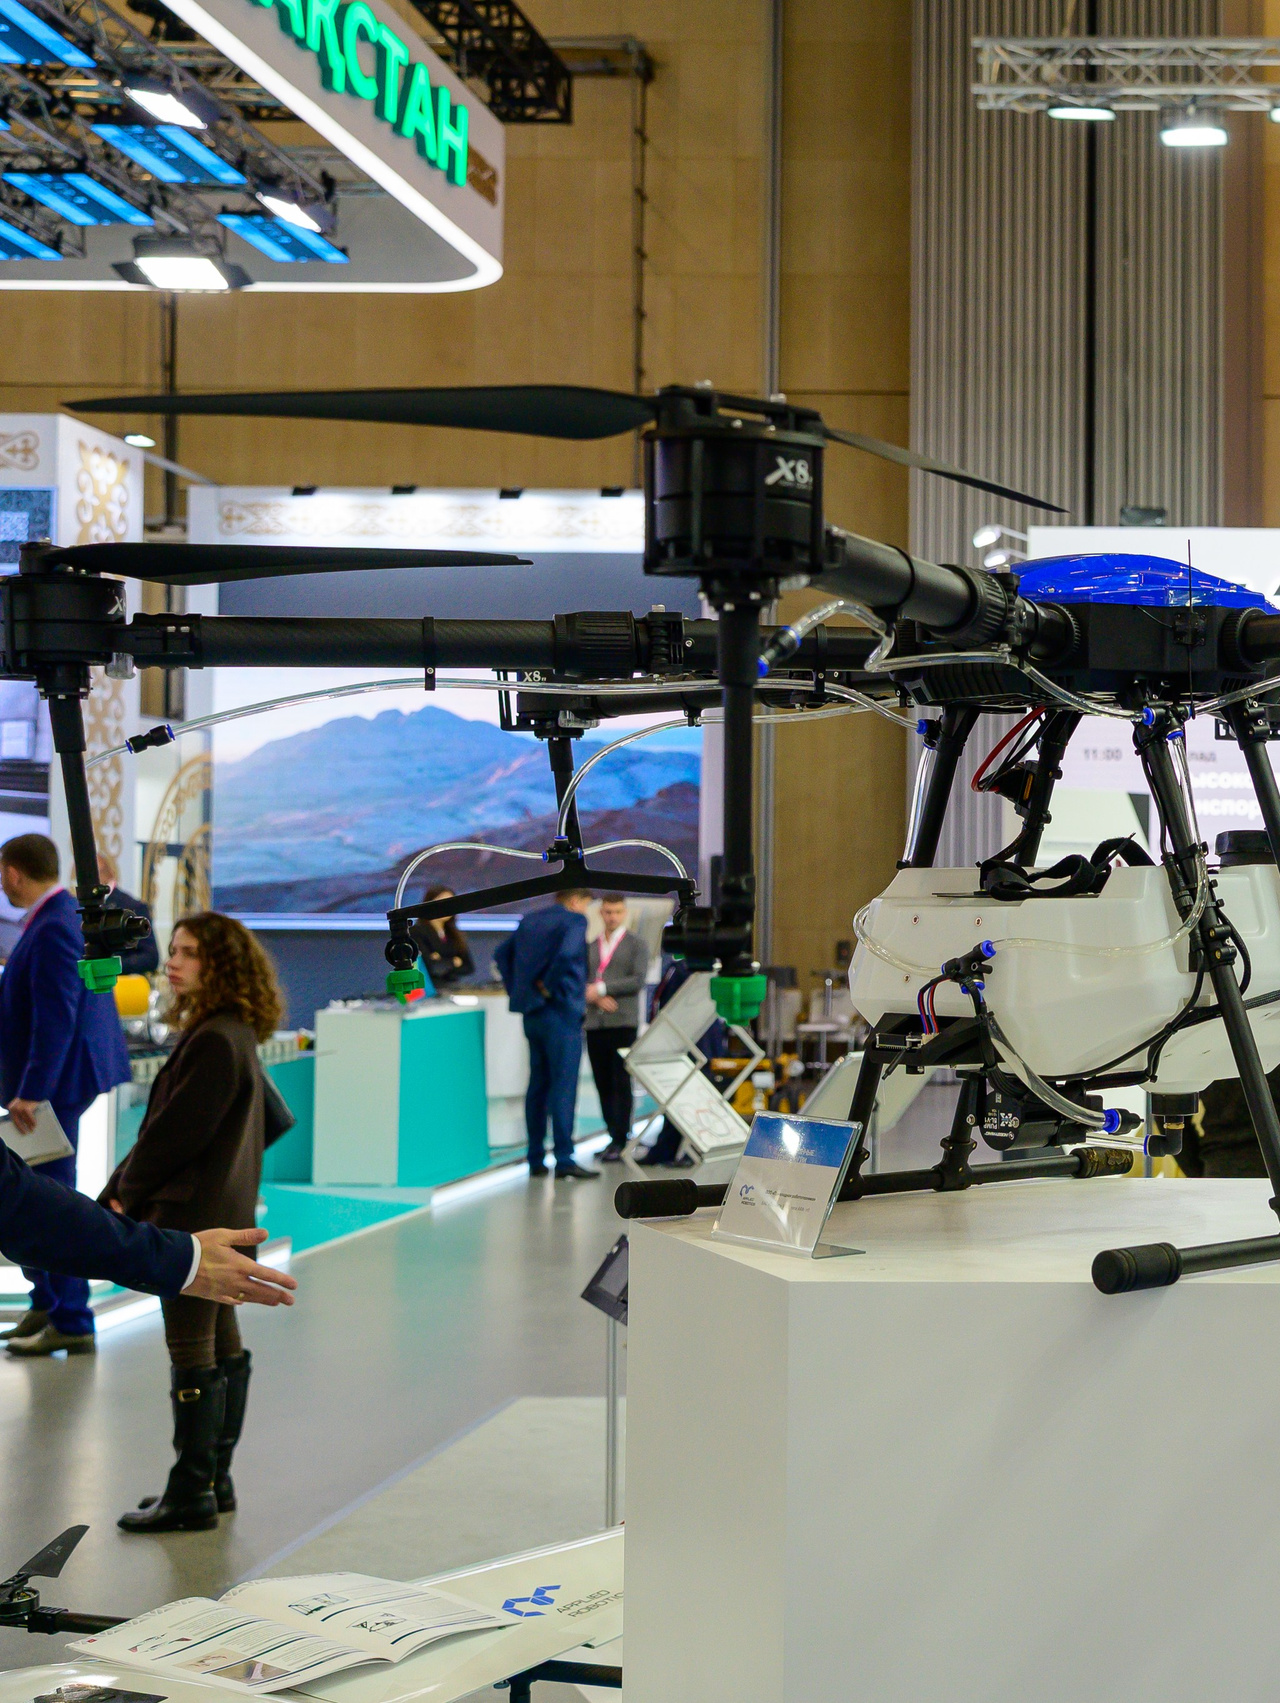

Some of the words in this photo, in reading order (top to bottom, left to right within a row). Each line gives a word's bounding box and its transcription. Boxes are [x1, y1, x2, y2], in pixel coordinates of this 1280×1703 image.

[764, 456, 810, 485] X8
[556, 1589, 611, 1614] APPLIED
[567, 1591, 624, 1618] ROBOTIC
